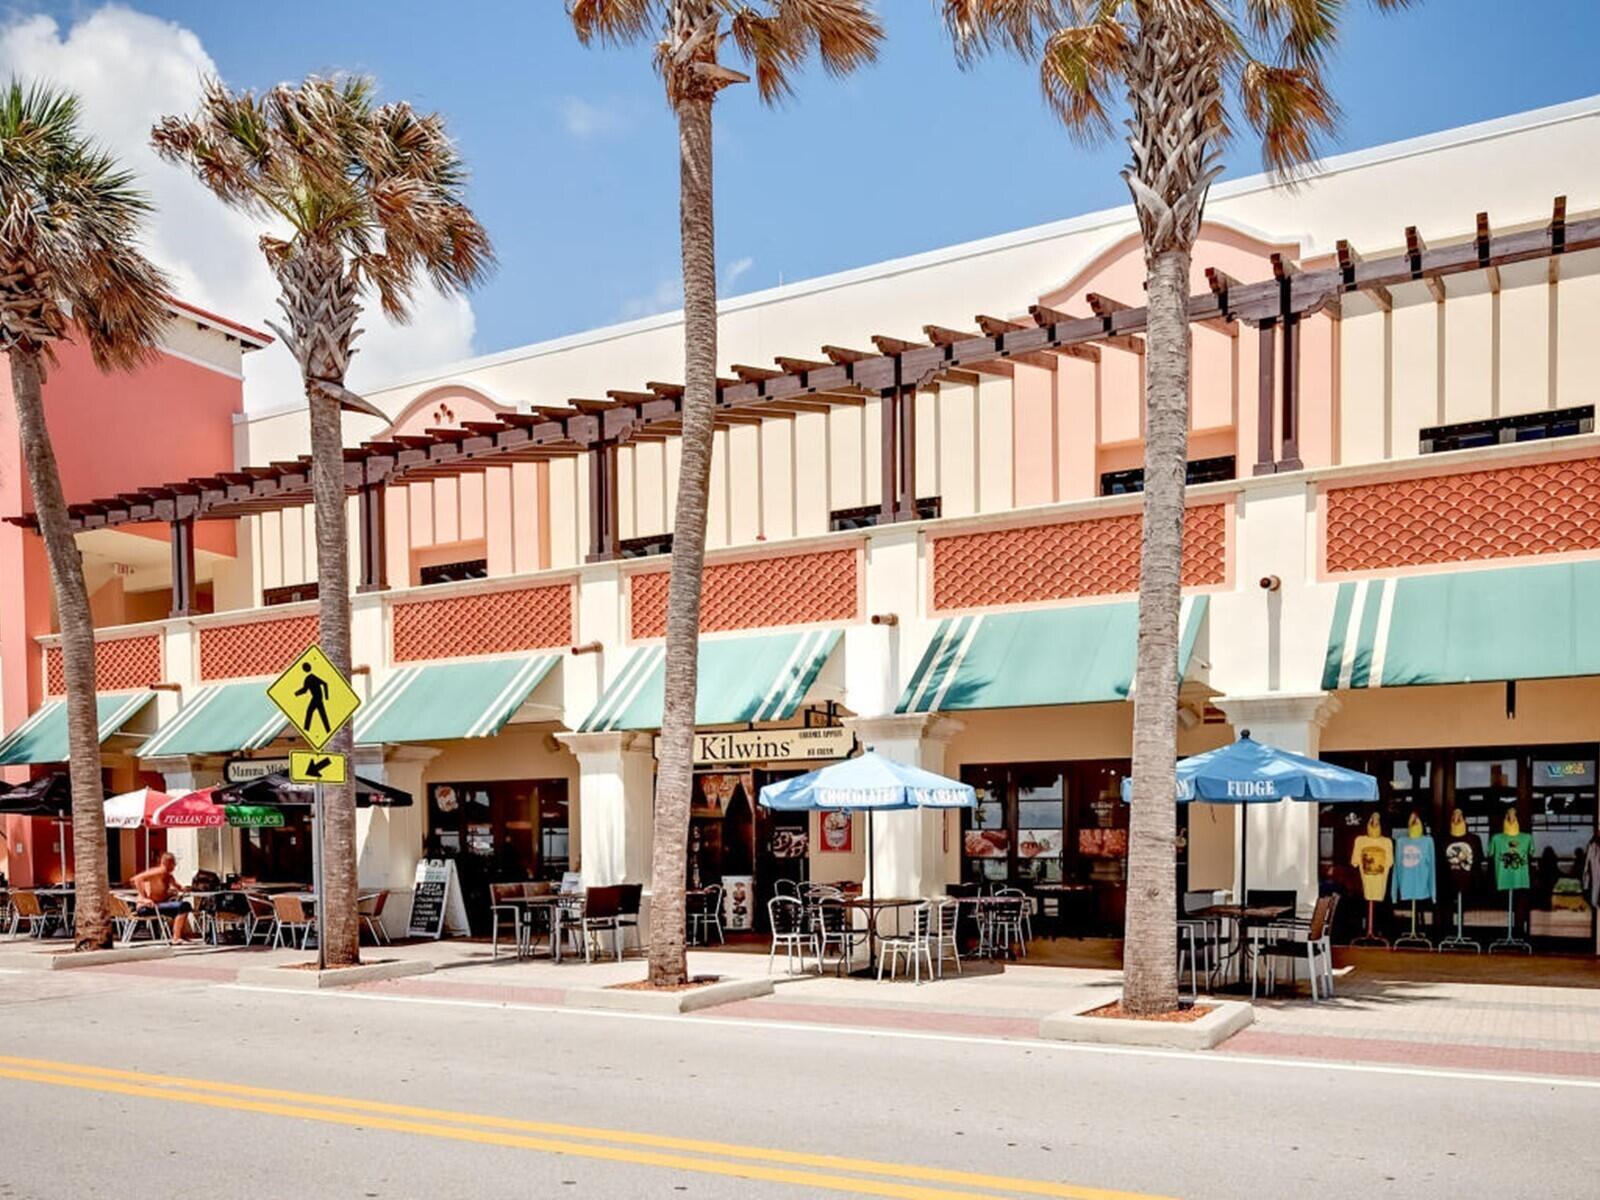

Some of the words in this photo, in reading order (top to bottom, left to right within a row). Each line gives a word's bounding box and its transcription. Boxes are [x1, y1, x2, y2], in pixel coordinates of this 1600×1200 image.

[700, 735, 790, 760] Kilwins
[1227, 780, 1275, 796] FUDGE
[163, 815, 202, 825] ITALIAN
[205, 815, 222, 825] ICE
